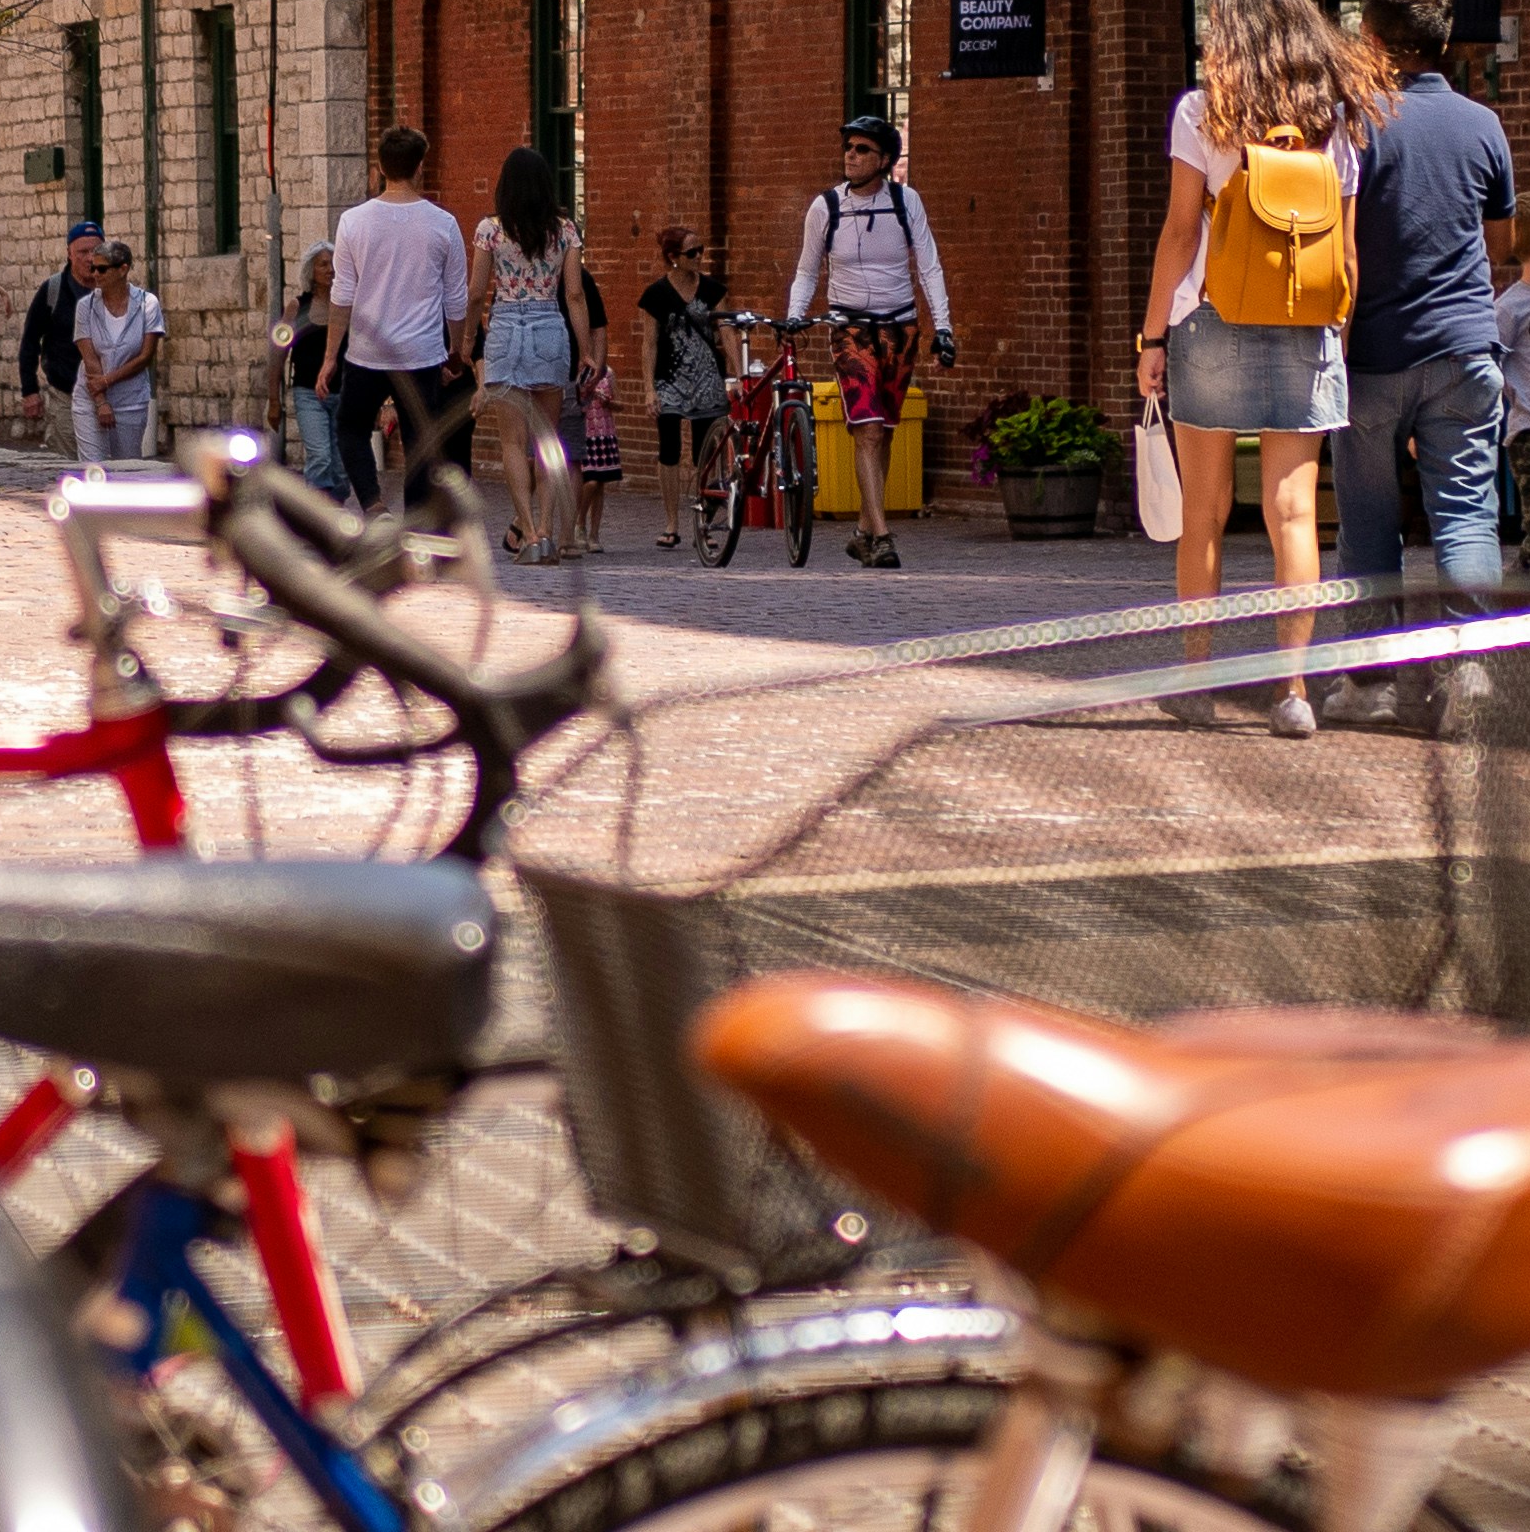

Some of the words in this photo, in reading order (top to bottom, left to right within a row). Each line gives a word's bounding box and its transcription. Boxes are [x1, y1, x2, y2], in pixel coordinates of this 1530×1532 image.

[960, 0, 1013, 14] BEAUTY
[960, 15, 1032, 30] COMPANY.
[959, 40, 997, 52] DECIEM
